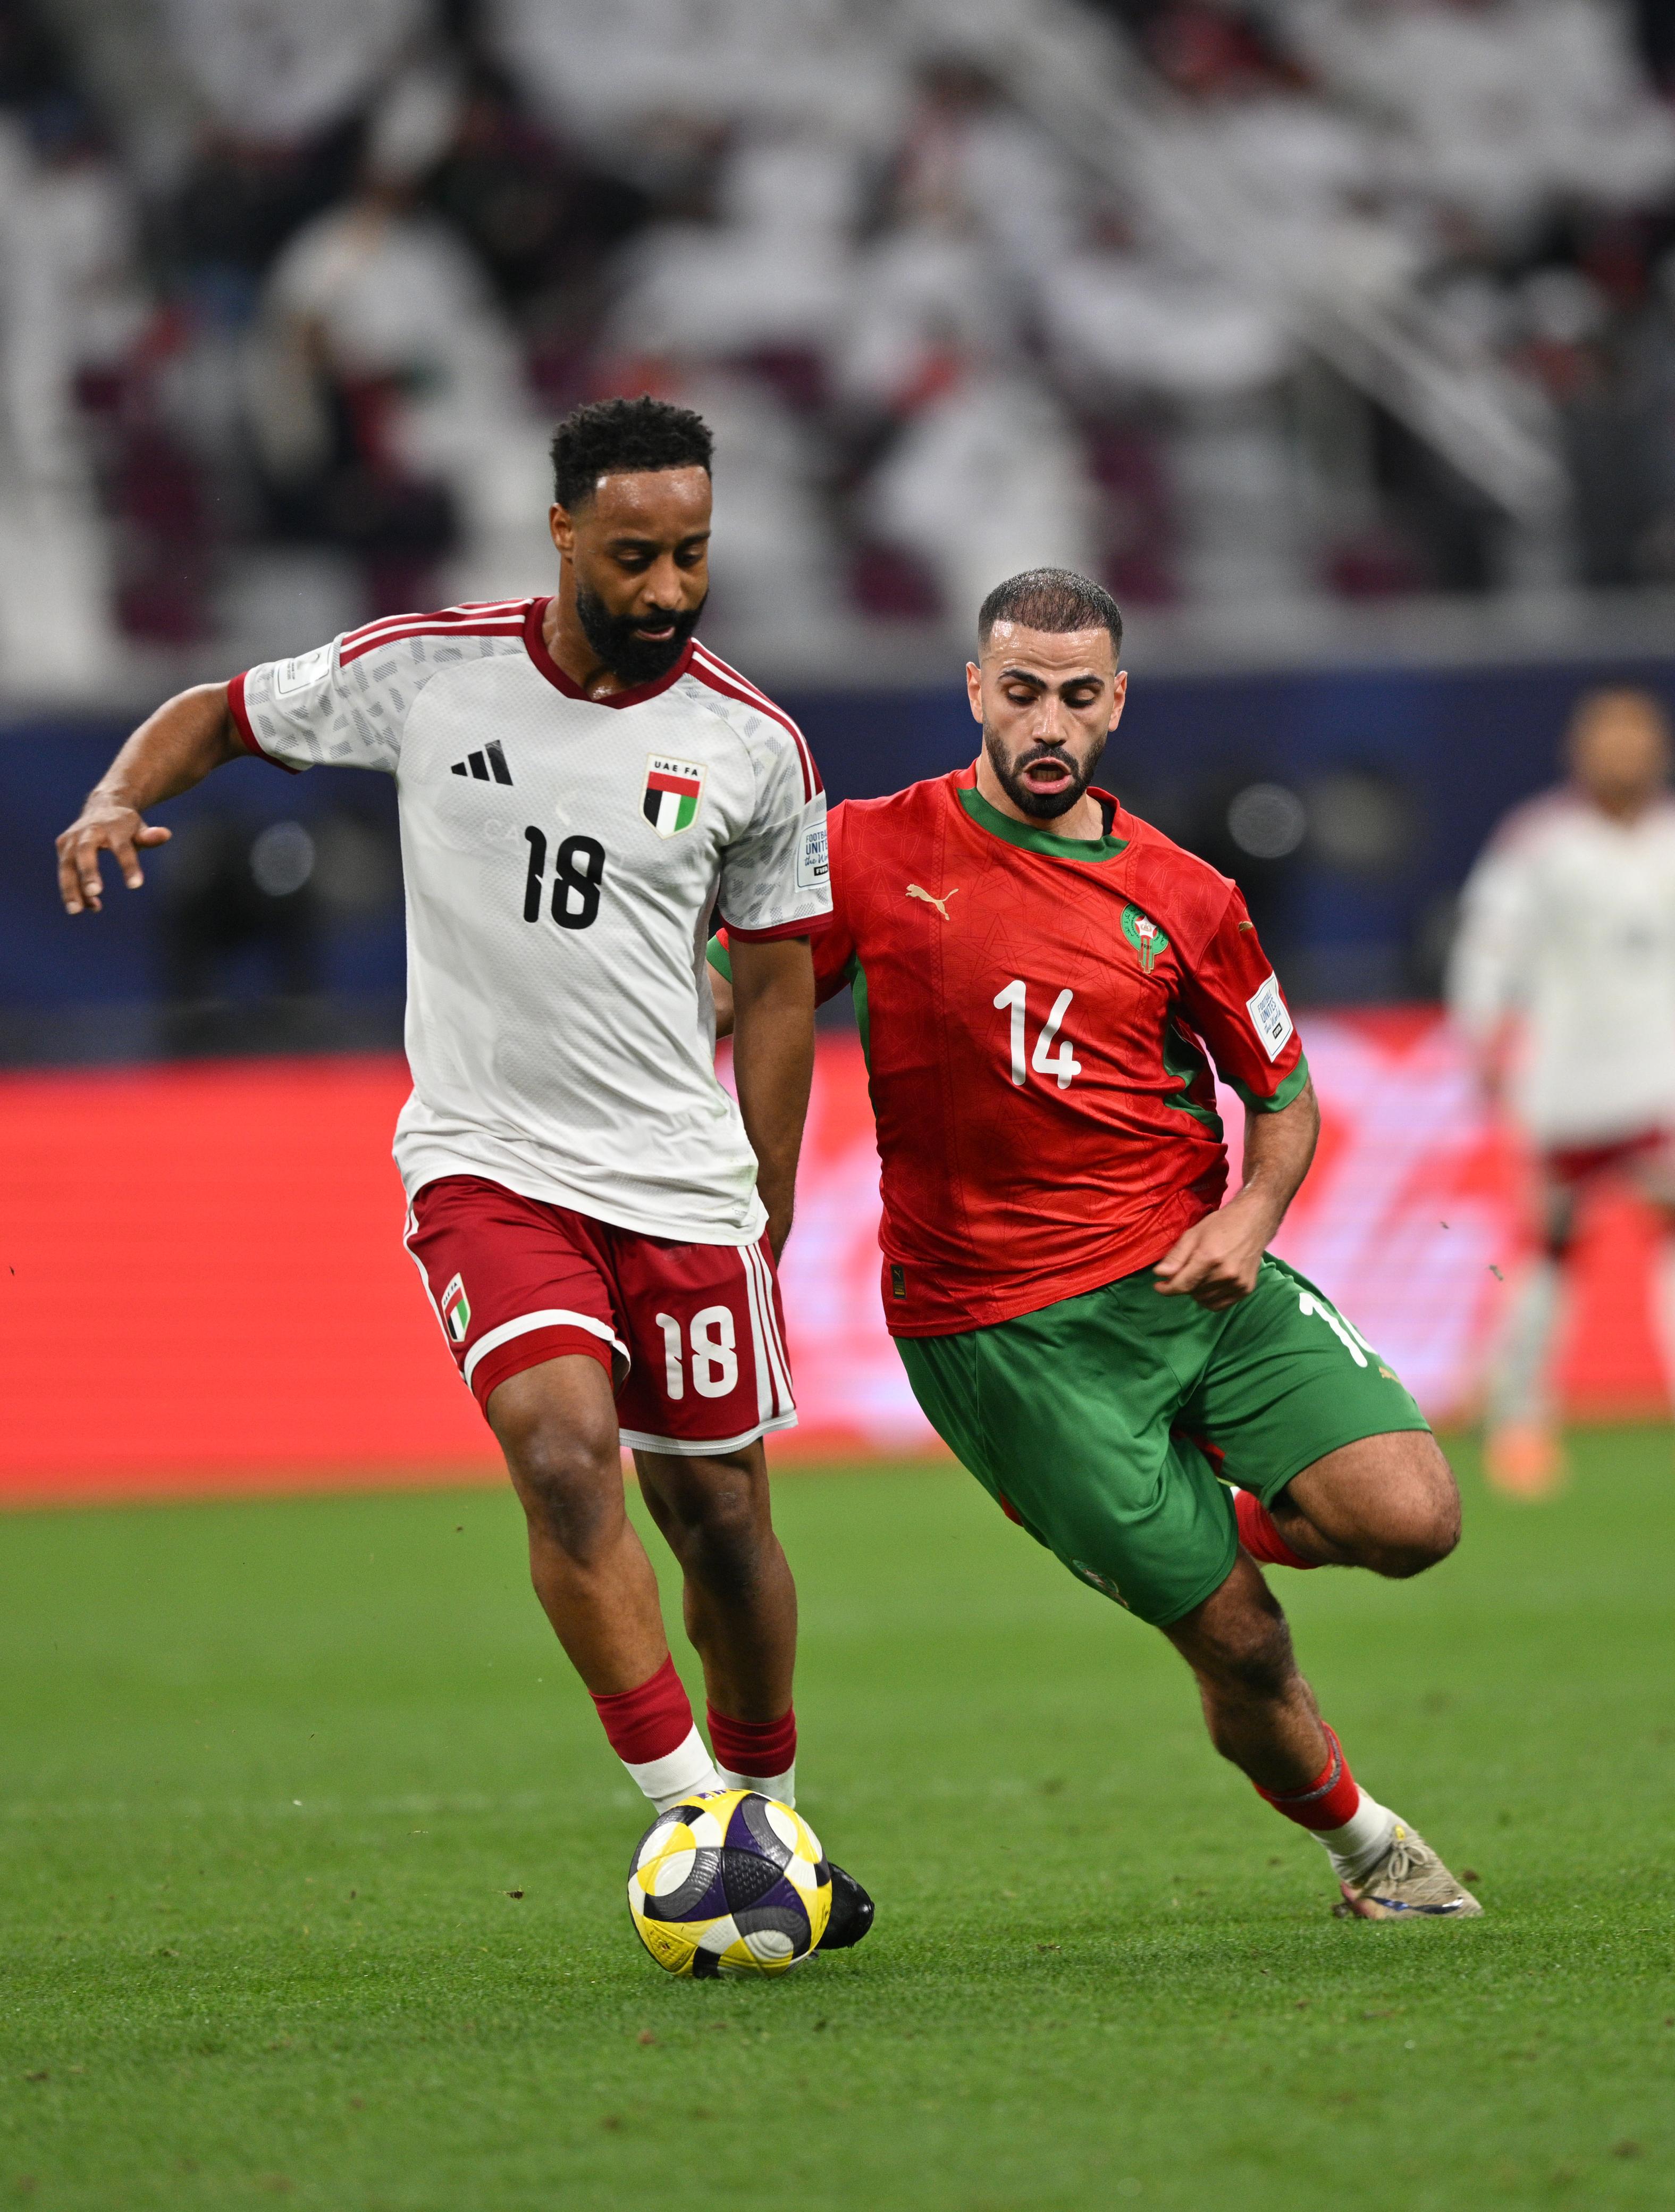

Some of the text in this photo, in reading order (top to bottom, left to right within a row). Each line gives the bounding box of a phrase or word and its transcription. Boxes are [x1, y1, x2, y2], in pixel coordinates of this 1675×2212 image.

[654, 761, 698, 776] UAE FA
[524, 825, 605, 929] 18
[1257, 989, 1272, 1013] FOOTBALL
[1260, 996, 1276, 1024] UNITES
[993, 979, 1082, 1090] 14
[655, 1305, 738, 1400] 18
